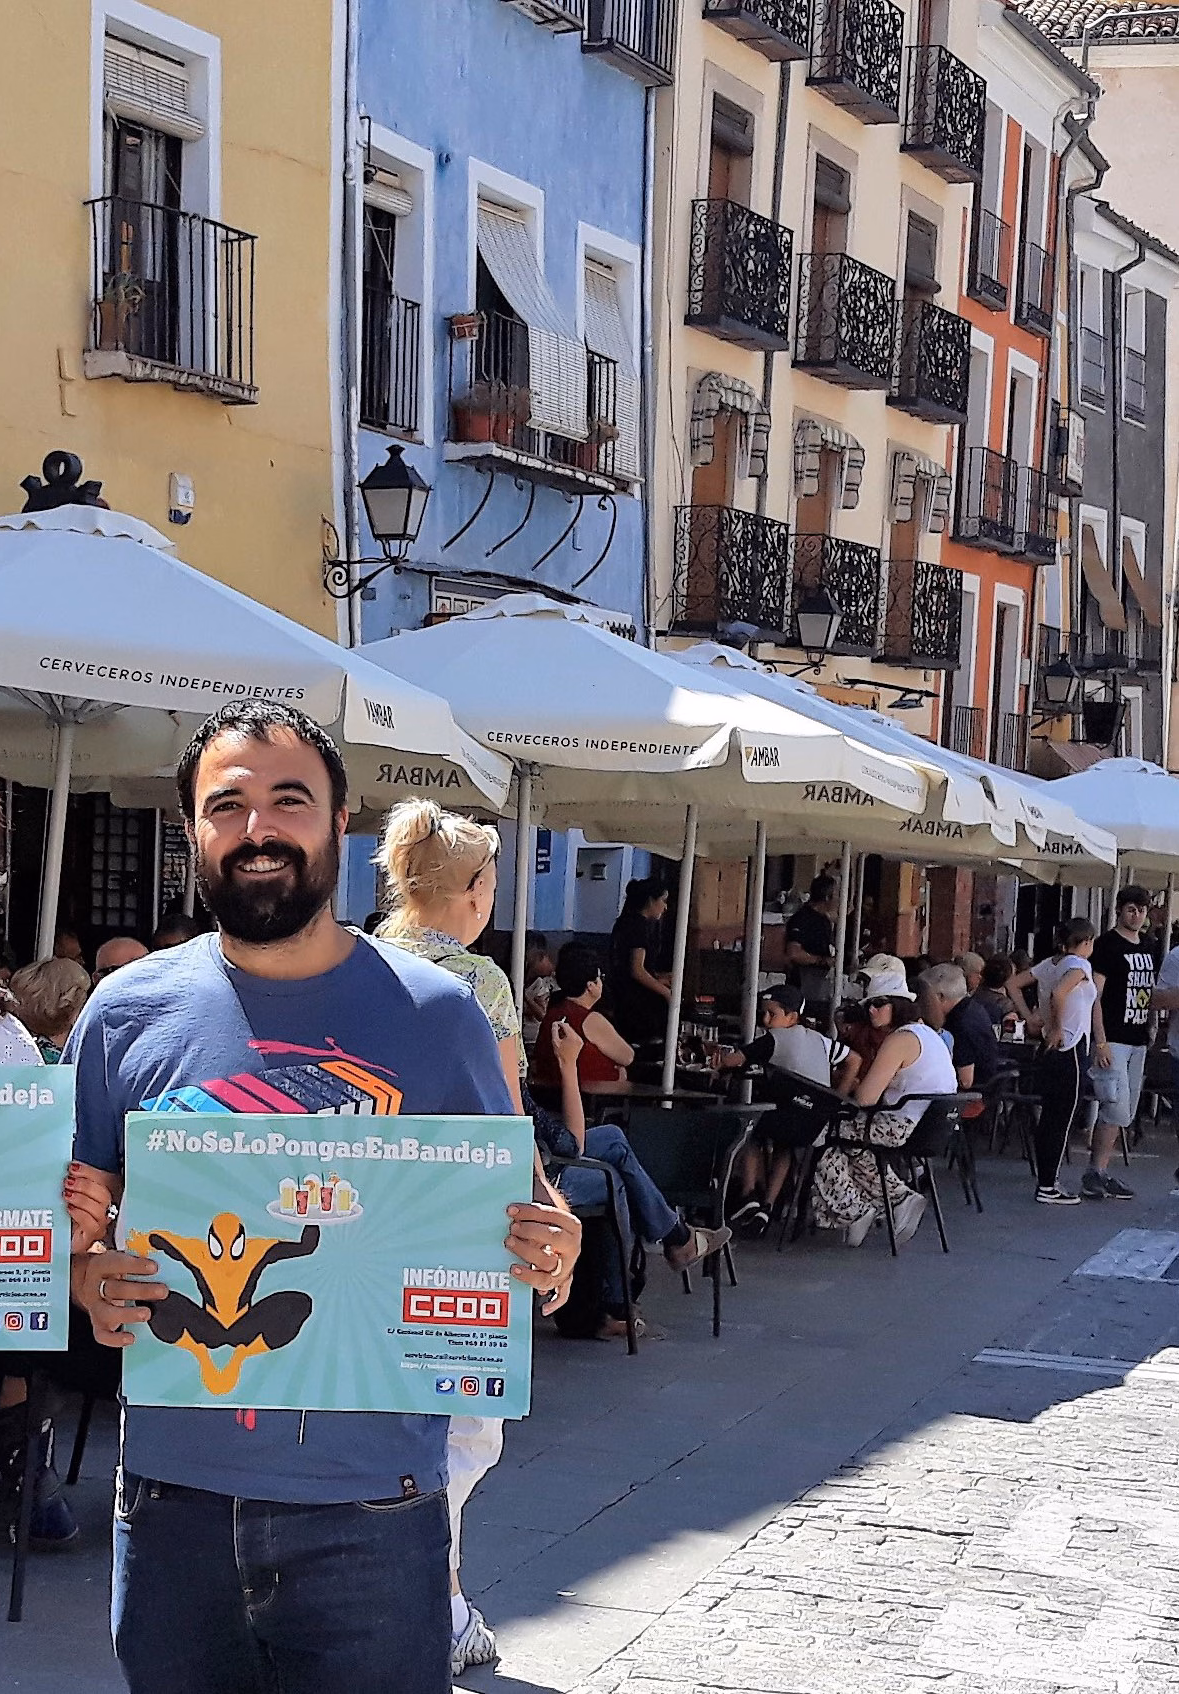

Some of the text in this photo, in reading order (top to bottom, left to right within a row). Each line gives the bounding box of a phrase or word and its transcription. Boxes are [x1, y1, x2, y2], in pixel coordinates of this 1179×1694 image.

[39, 656, 305, 700] CERVECEROS INDEPENDIENTES
[487, 731, 699, 755] CERVECEROS INDEPENDIENTE
[750, 747, 780, 767] AMBAR
[1123, 953, 1154, 971] YOU
[146, 1129, 512, 1169] #NoSeLoPongasEnBandeja
[402, 1265, 510, 1290] INFÓRMATE
[409, 1295, 502, 1320] CCOO
